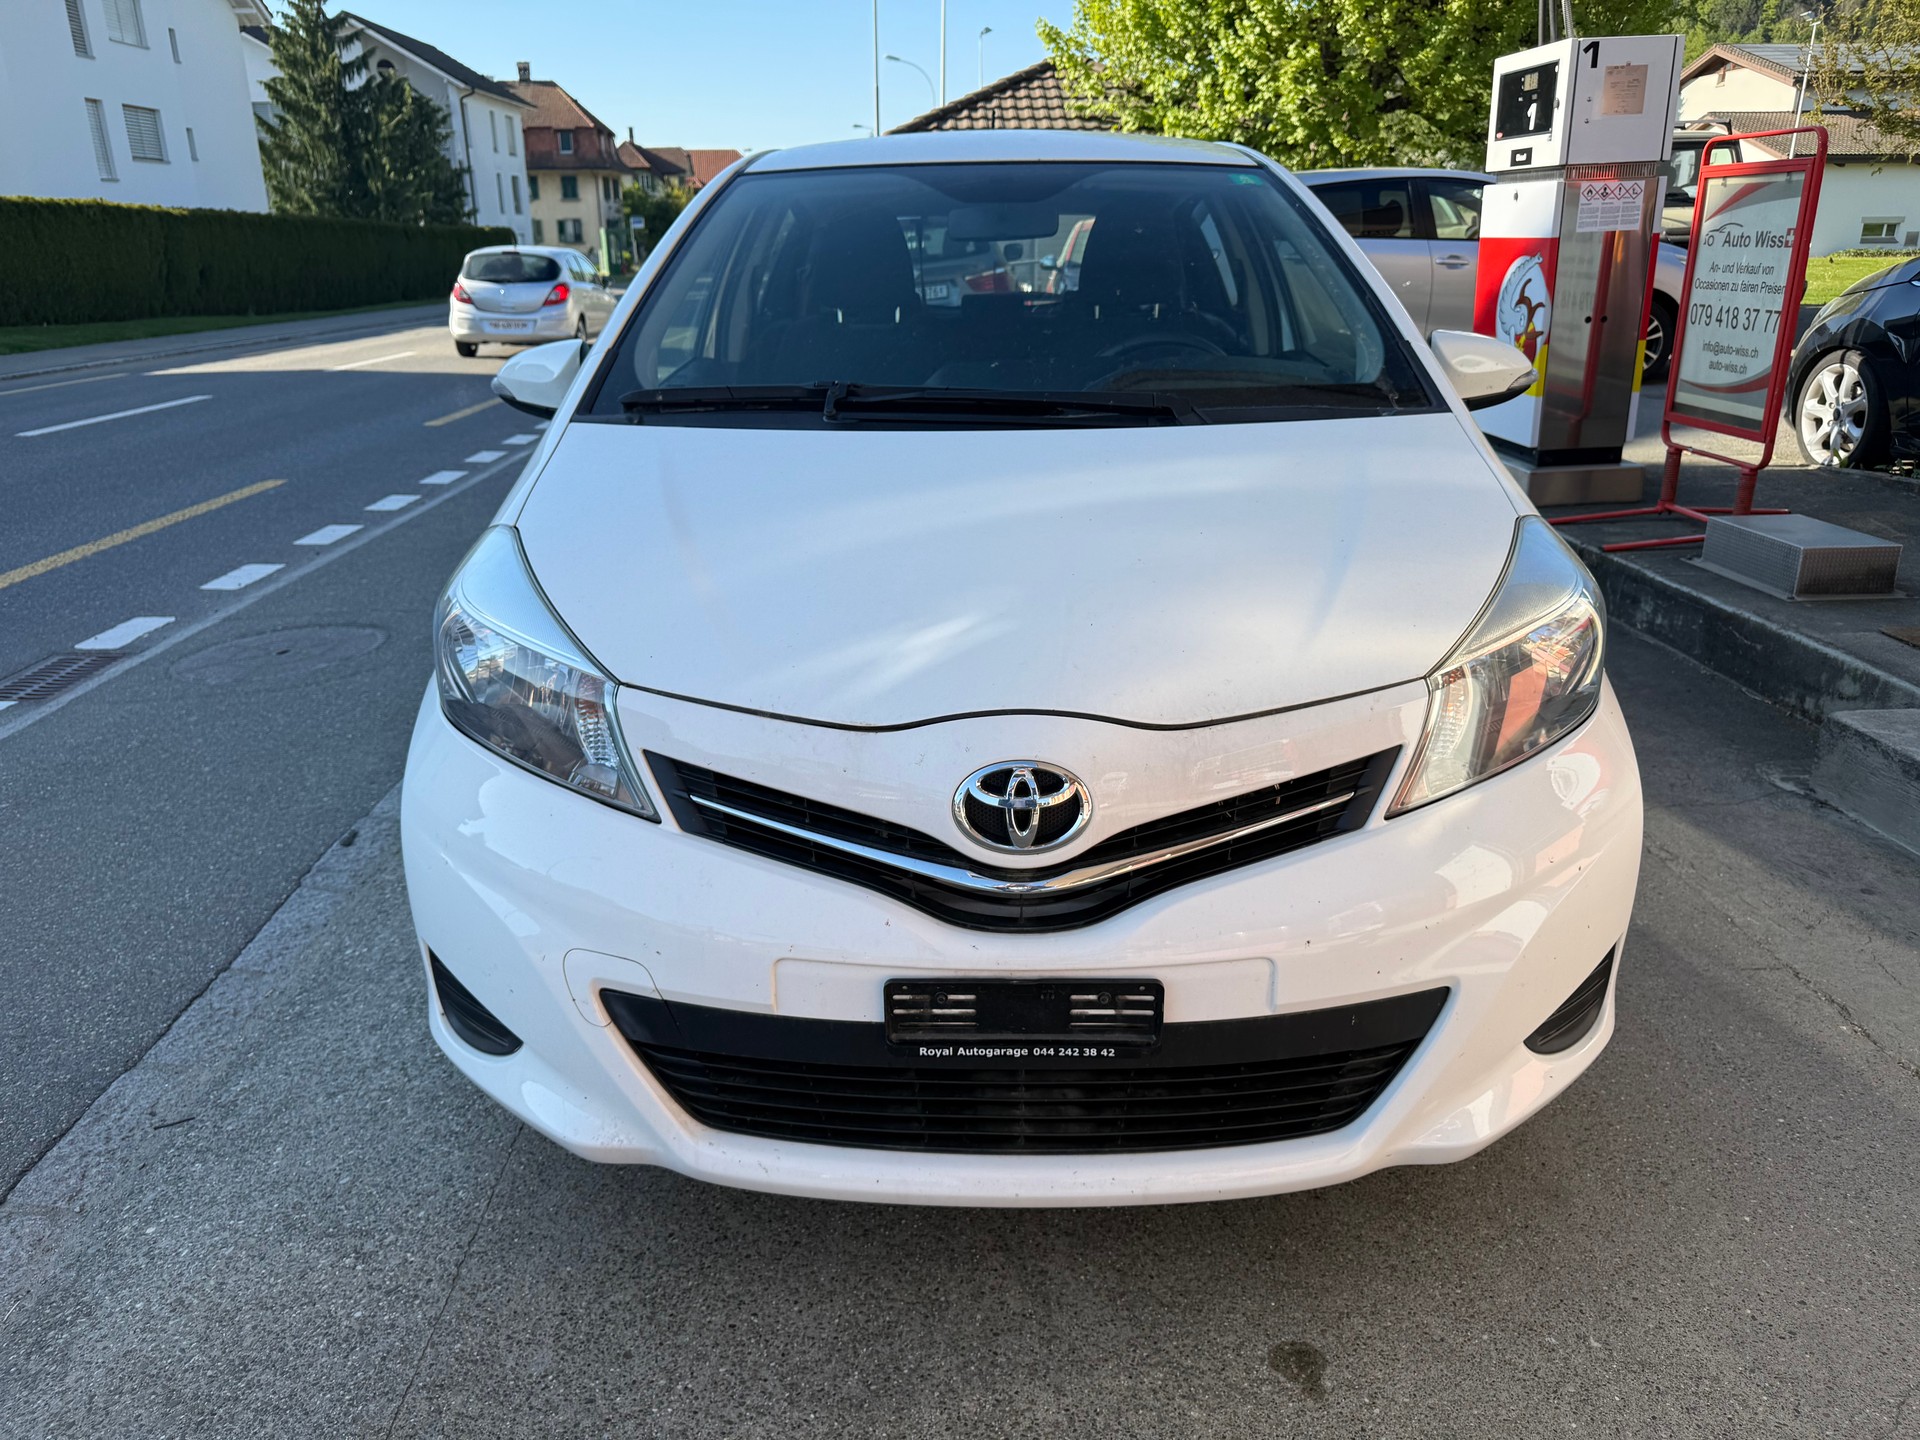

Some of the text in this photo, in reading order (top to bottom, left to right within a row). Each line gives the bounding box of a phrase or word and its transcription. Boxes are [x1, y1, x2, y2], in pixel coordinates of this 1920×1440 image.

[1583, 41, 1600, 69] 1
[1527, 102, 1538, 131] 1
[1722, 231, 1785, 249] Auto Wiss
[1709, 261, 1775, 276] An- und Verkauf von
[1694, 278, 1729, 292] Occasionen
[1730, 282, 1739, 292] zu
[1739, 280, 1759, 294] fairen
[1690, 303, 1782, 334] 079 418 37 77
[1702, 340, 1759, 359] info@auto-wiss.ch
[1708, 360, 1748, 375] auto-wiss.ch
[919, 1047, 1116, 1058] Royal Autogarage 044 242 38 42
